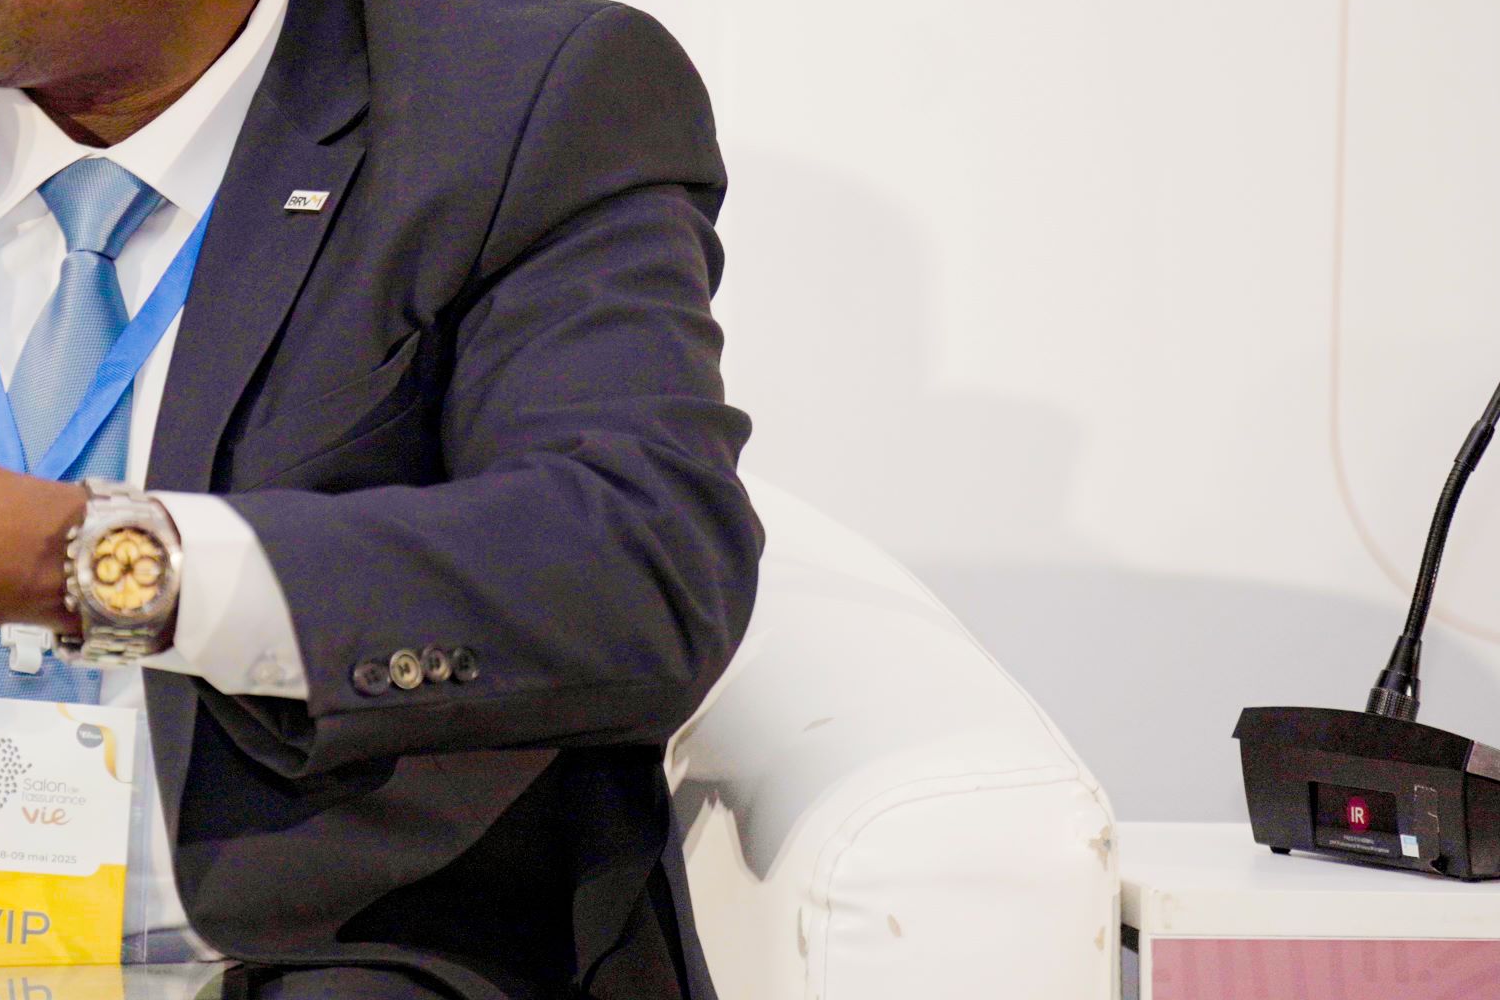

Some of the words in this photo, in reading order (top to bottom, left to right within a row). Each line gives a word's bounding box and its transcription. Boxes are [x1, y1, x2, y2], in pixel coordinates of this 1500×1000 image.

[22, 778, 67, 793] Salon
[21, 806, 73, 826] vie
[1350, 806, 1365, 825] IR
